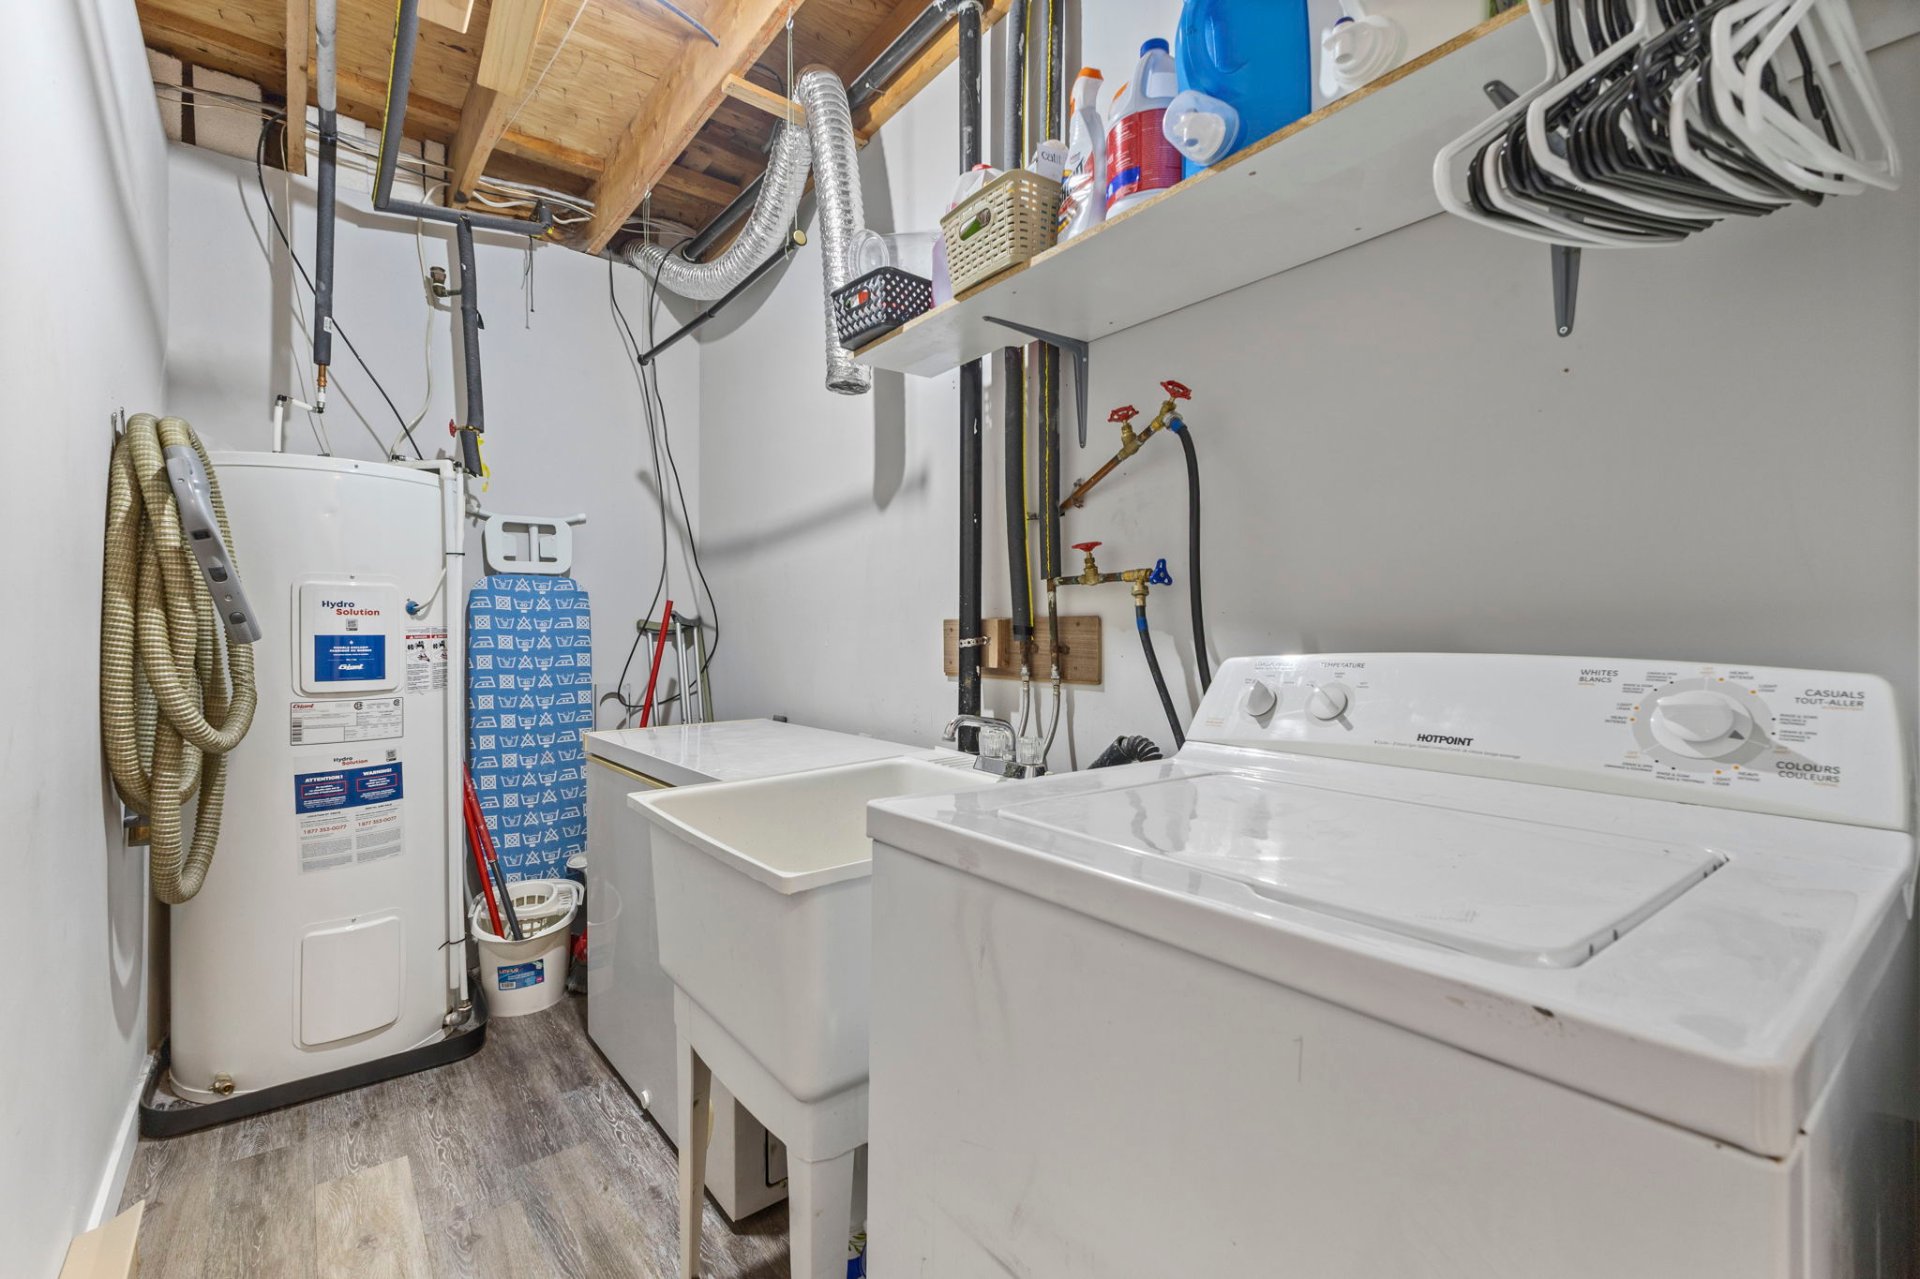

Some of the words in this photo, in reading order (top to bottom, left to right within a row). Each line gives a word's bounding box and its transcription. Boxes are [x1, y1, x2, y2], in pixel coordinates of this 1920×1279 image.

[322, 600, 355, 609] Hydro
[336, 608, 380, 616] Solution
[1580, 669, 1619, 677] WHITES
[1804, 689, 1865, 699] CASUALS
[1794, 697, 1865, 707] TOUT-ALLER
[1417, 733, 1474, 747] HOTPOINT
[1776, 761, 1841, 775] COLOURS
[1778, 770, 1841, 783] COULEURS
